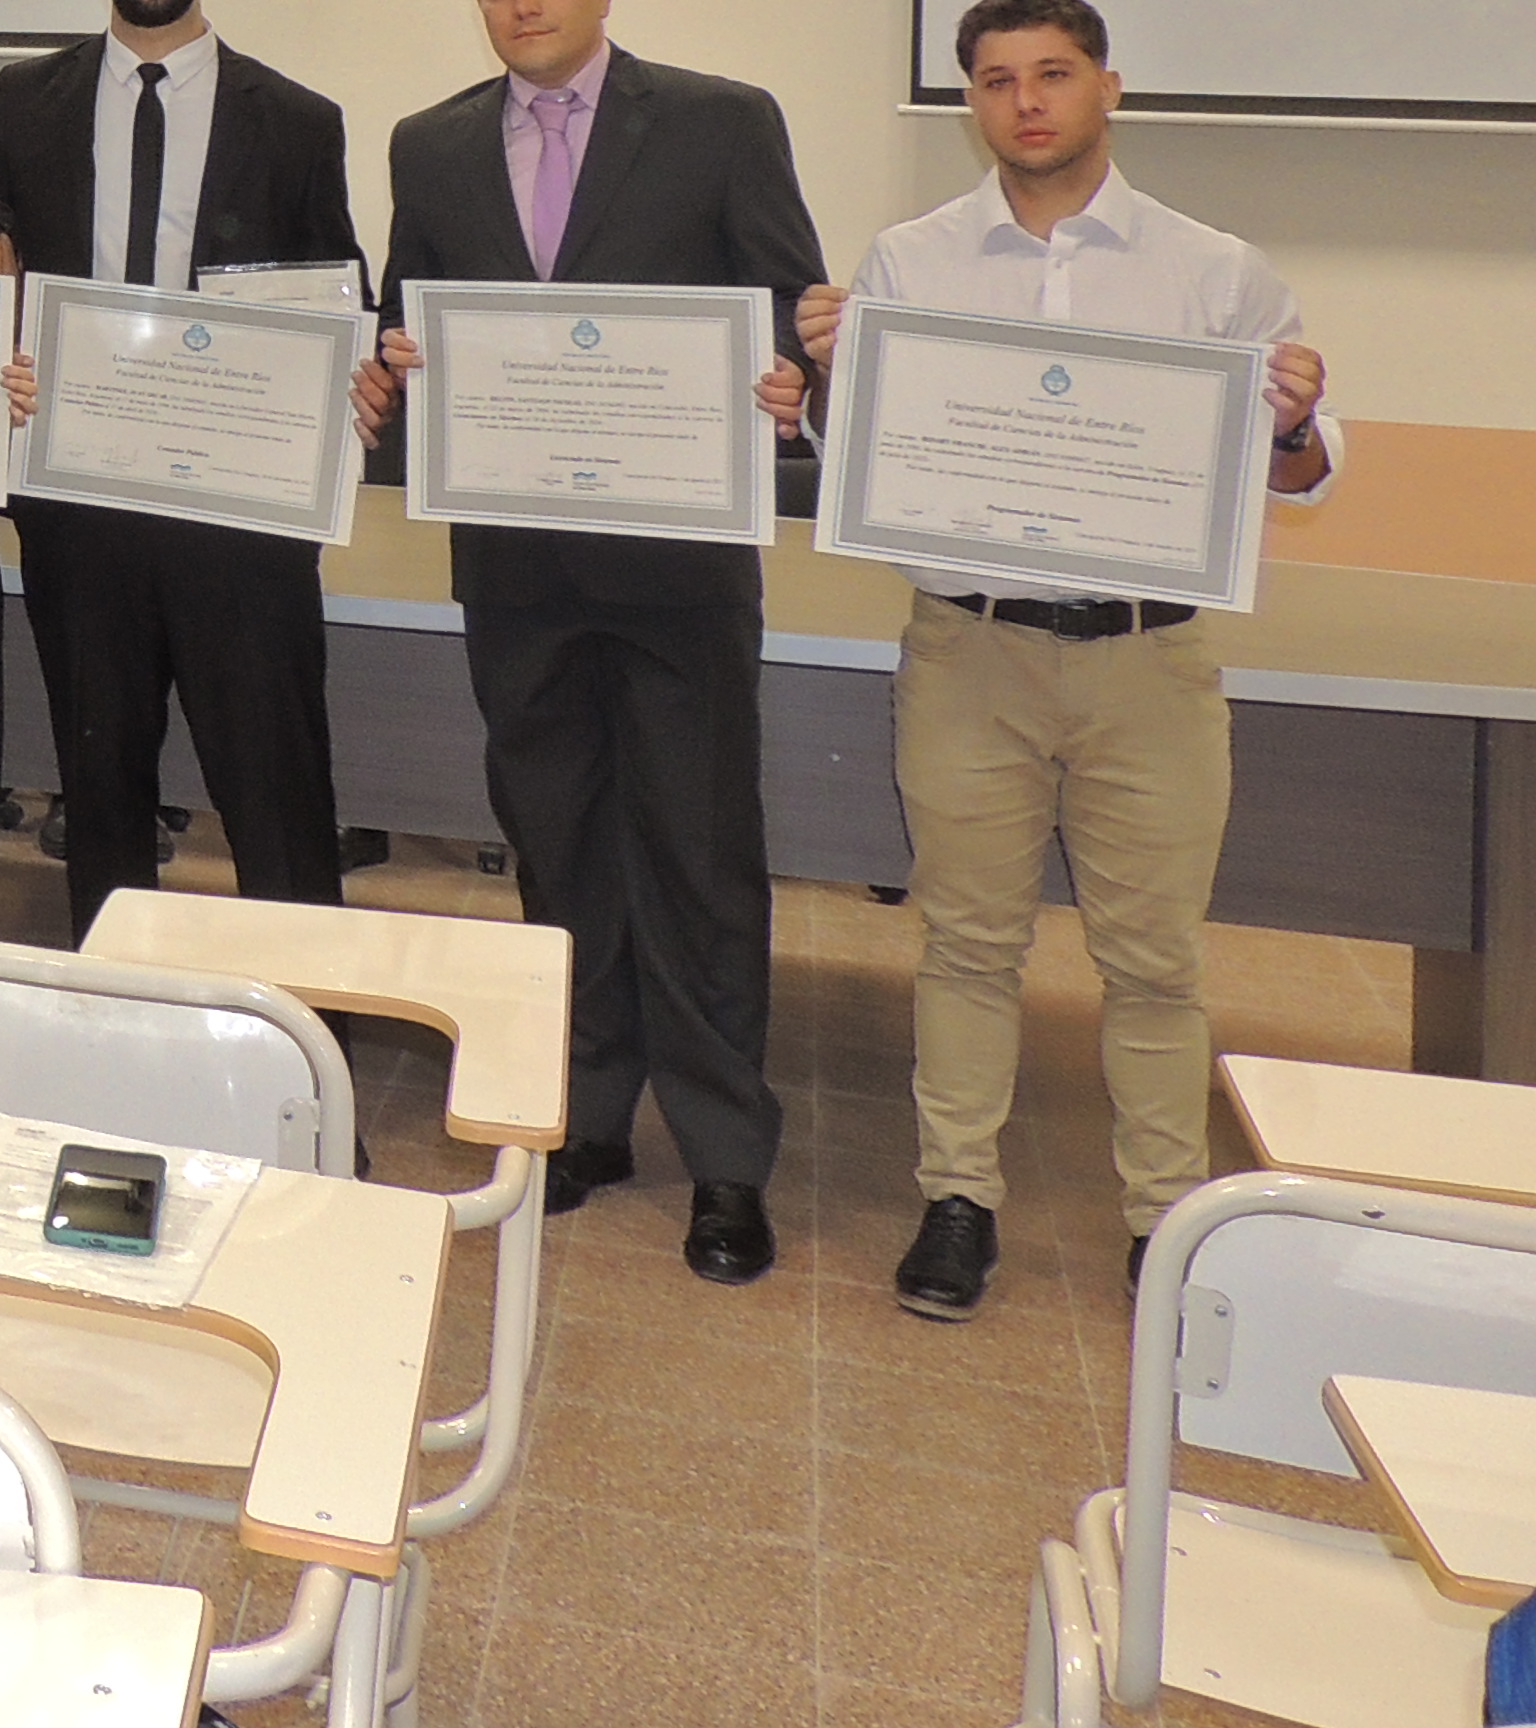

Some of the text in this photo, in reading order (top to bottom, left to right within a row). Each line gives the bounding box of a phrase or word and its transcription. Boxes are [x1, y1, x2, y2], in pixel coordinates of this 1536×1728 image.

[113, 354, 167, 369] Universidad
[169, 362, 209, 375] Nacional
[210, 367, 222, 377] de
[223, 369, 249, 380] Entre
[502, 361, 558, 372] Universidad
[604, 365, 616, 375] de
[944, 400, 1013, 418] Universidad
[1016, 409, 1067, 425] Nacional
[1068, 416, 1083, 427] de
[1085, 418, 1117, 431] Entre
